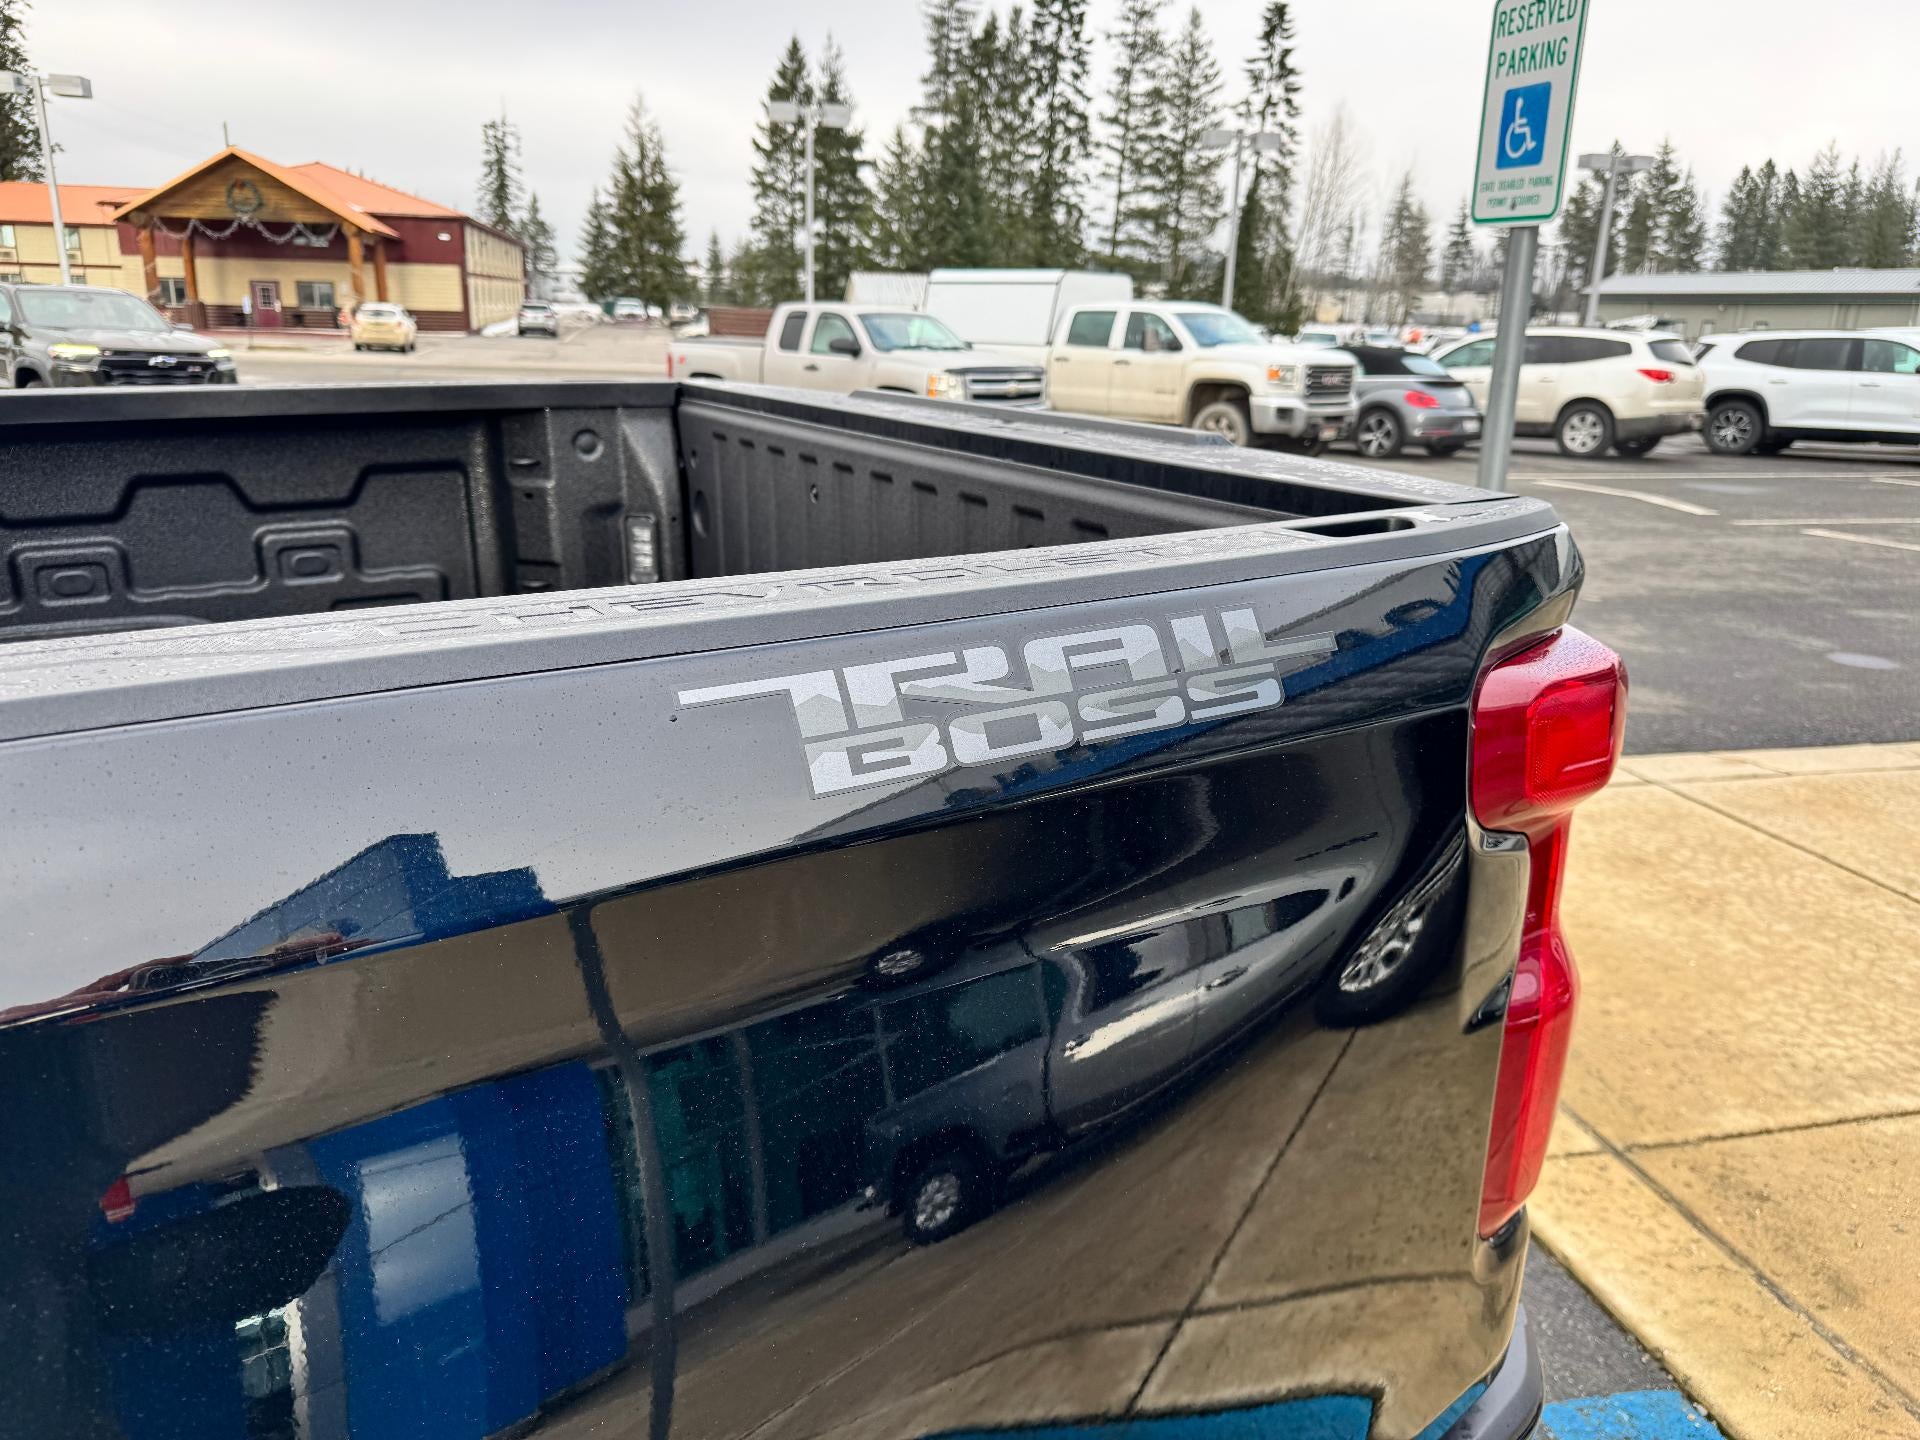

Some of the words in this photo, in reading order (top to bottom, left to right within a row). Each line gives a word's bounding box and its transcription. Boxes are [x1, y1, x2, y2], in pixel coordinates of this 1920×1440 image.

[1496, 36, 1568, 78] PARKING
[1497, 0, 1578, 38] RESERVED
[374, 545, 1170, 636] CHEVROLET
[678, 608, 1337, 738] TRAIL
[805, 662, 1283, 795] BOSS
